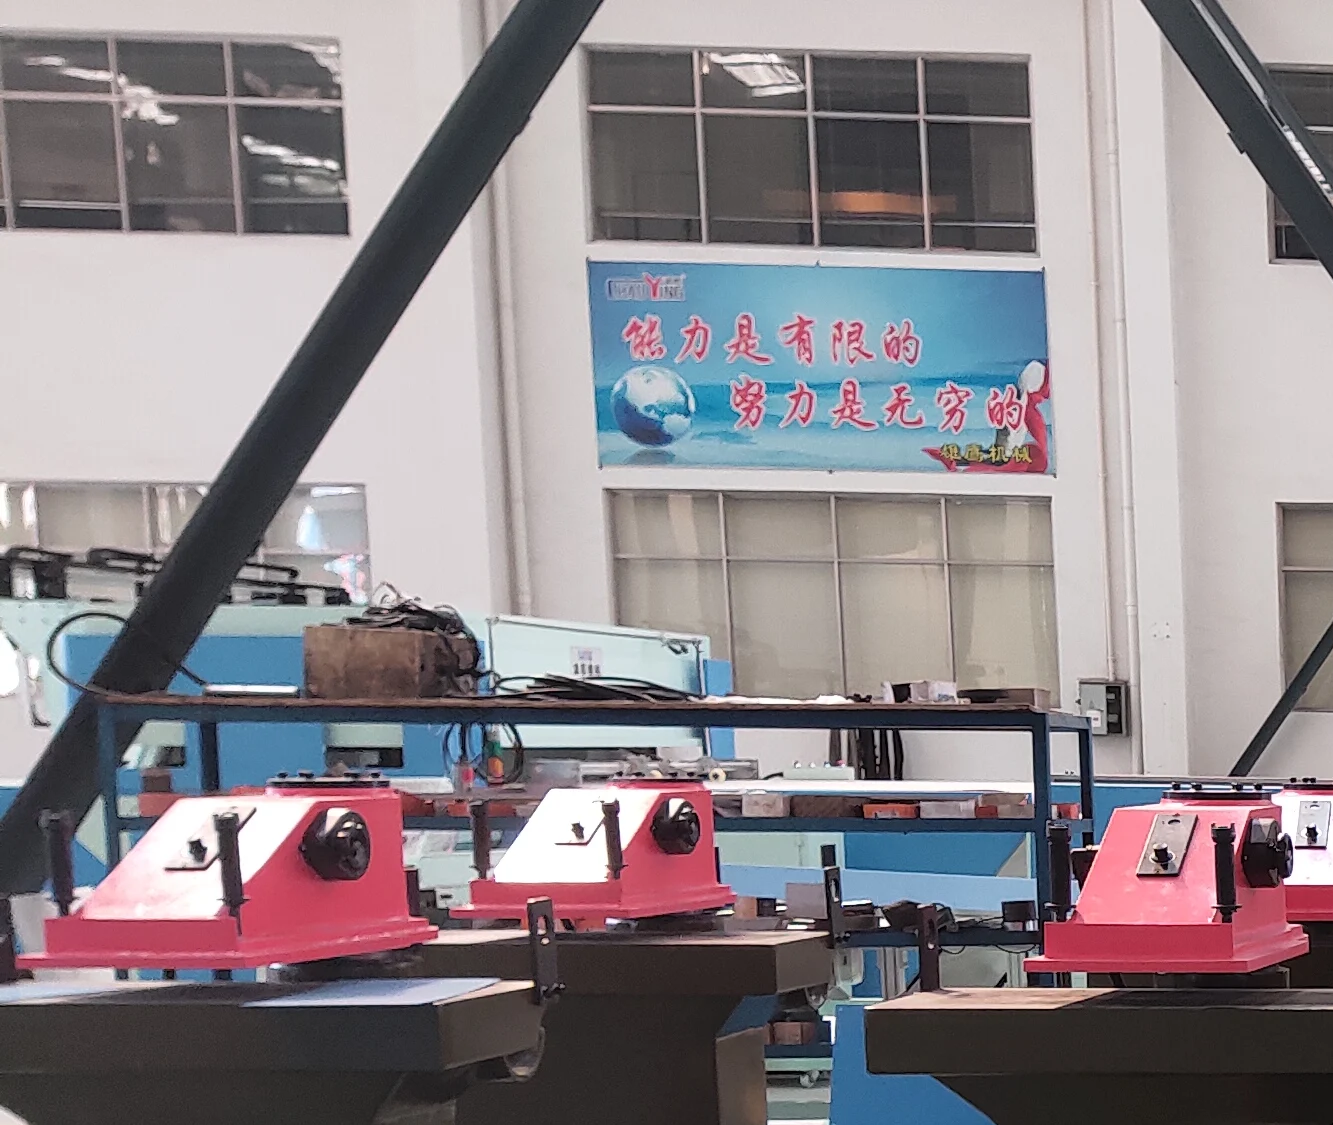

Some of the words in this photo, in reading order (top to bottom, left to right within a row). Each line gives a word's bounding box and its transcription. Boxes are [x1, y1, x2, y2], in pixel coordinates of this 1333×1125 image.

[623, 313, 922, 366] 能力是有限的
[731, 375, 1027, 433] 努力是无穷的
